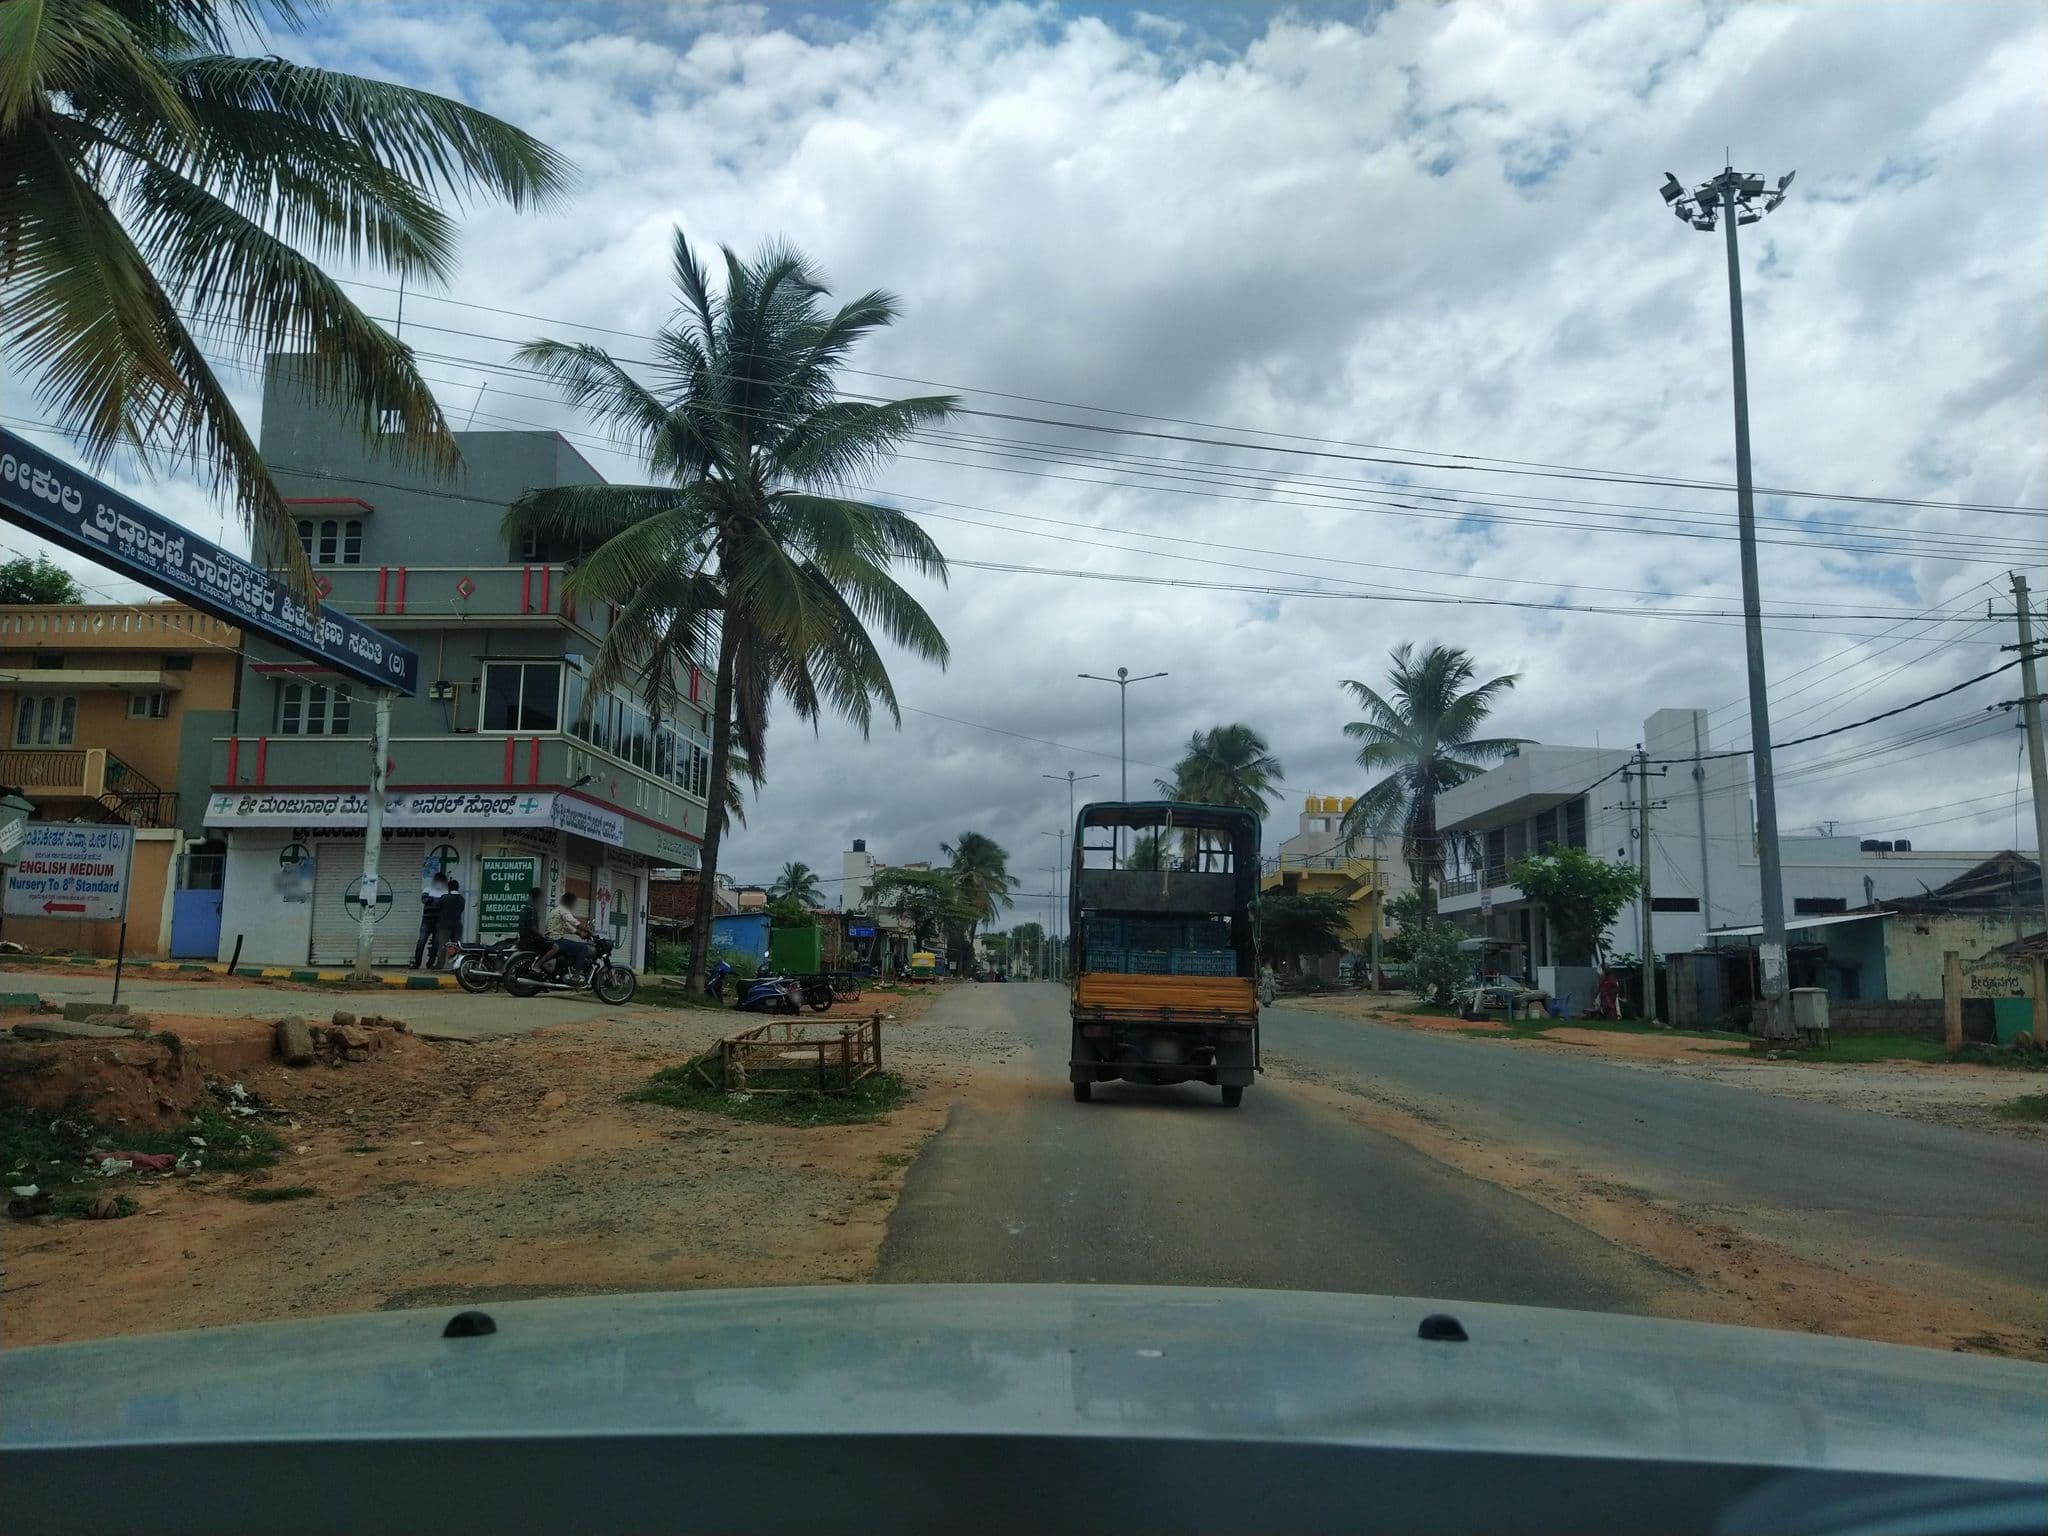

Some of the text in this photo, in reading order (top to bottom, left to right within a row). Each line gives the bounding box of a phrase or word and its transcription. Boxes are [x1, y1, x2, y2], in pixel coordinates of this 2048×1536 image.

[348, 631, 383, 665] ಸಮಿತಿ
[19, 860, 114, 877] ENGLISH MEDIUM
[484, 861, 533, 870] MANJUNATHA
[490, 873, 525, 881] CLINIC
[9, 876, 46, 894] Nursery
[49, 878, 60, 890] To
[76, 879, 119, 893] Standard
[503, 883, 510, 891] &
